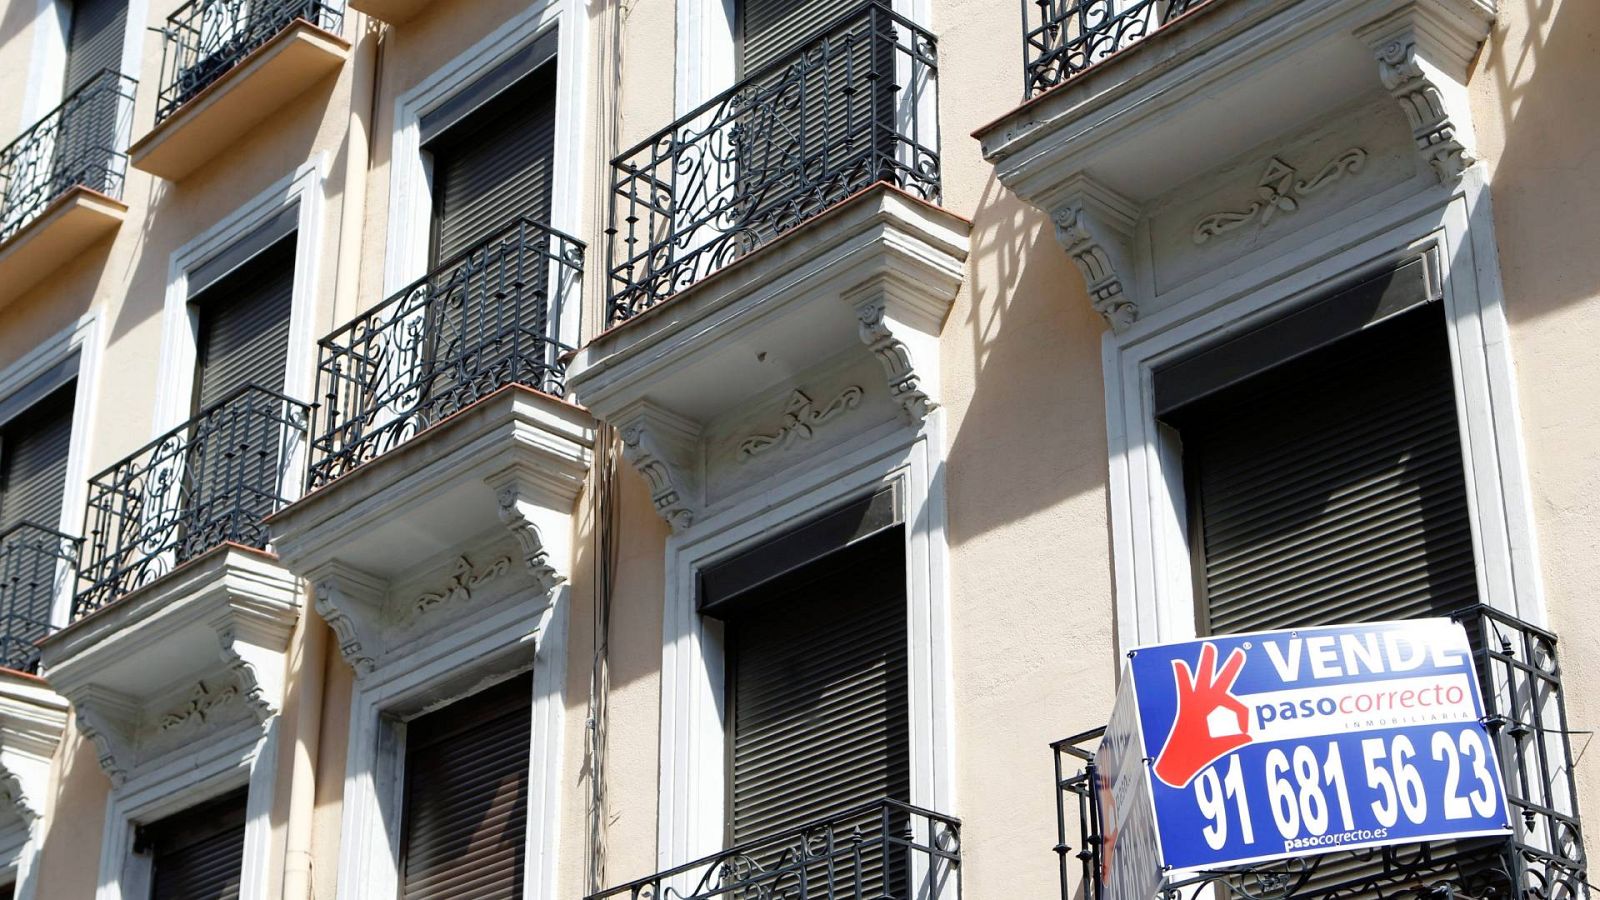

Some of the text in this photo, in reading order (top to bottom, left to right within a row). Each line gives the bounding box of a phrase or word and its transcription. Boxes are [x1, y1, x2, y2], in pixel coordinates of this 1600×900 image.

[1263, 629, 1467, 683] VENDE
[1255, 683, 1464, 730] pasocorrecto
[1344, 711, 1470, 730] INMOBILIARIA
[1194, 754, 1255, 851] 91
[1265, 741, 1355, 839] 681
[1361, 734, 1428, 828] 56
[1431, 728, 1498, 821] 23
[1284, 826, 1388, 853] pasocorrecto.es
